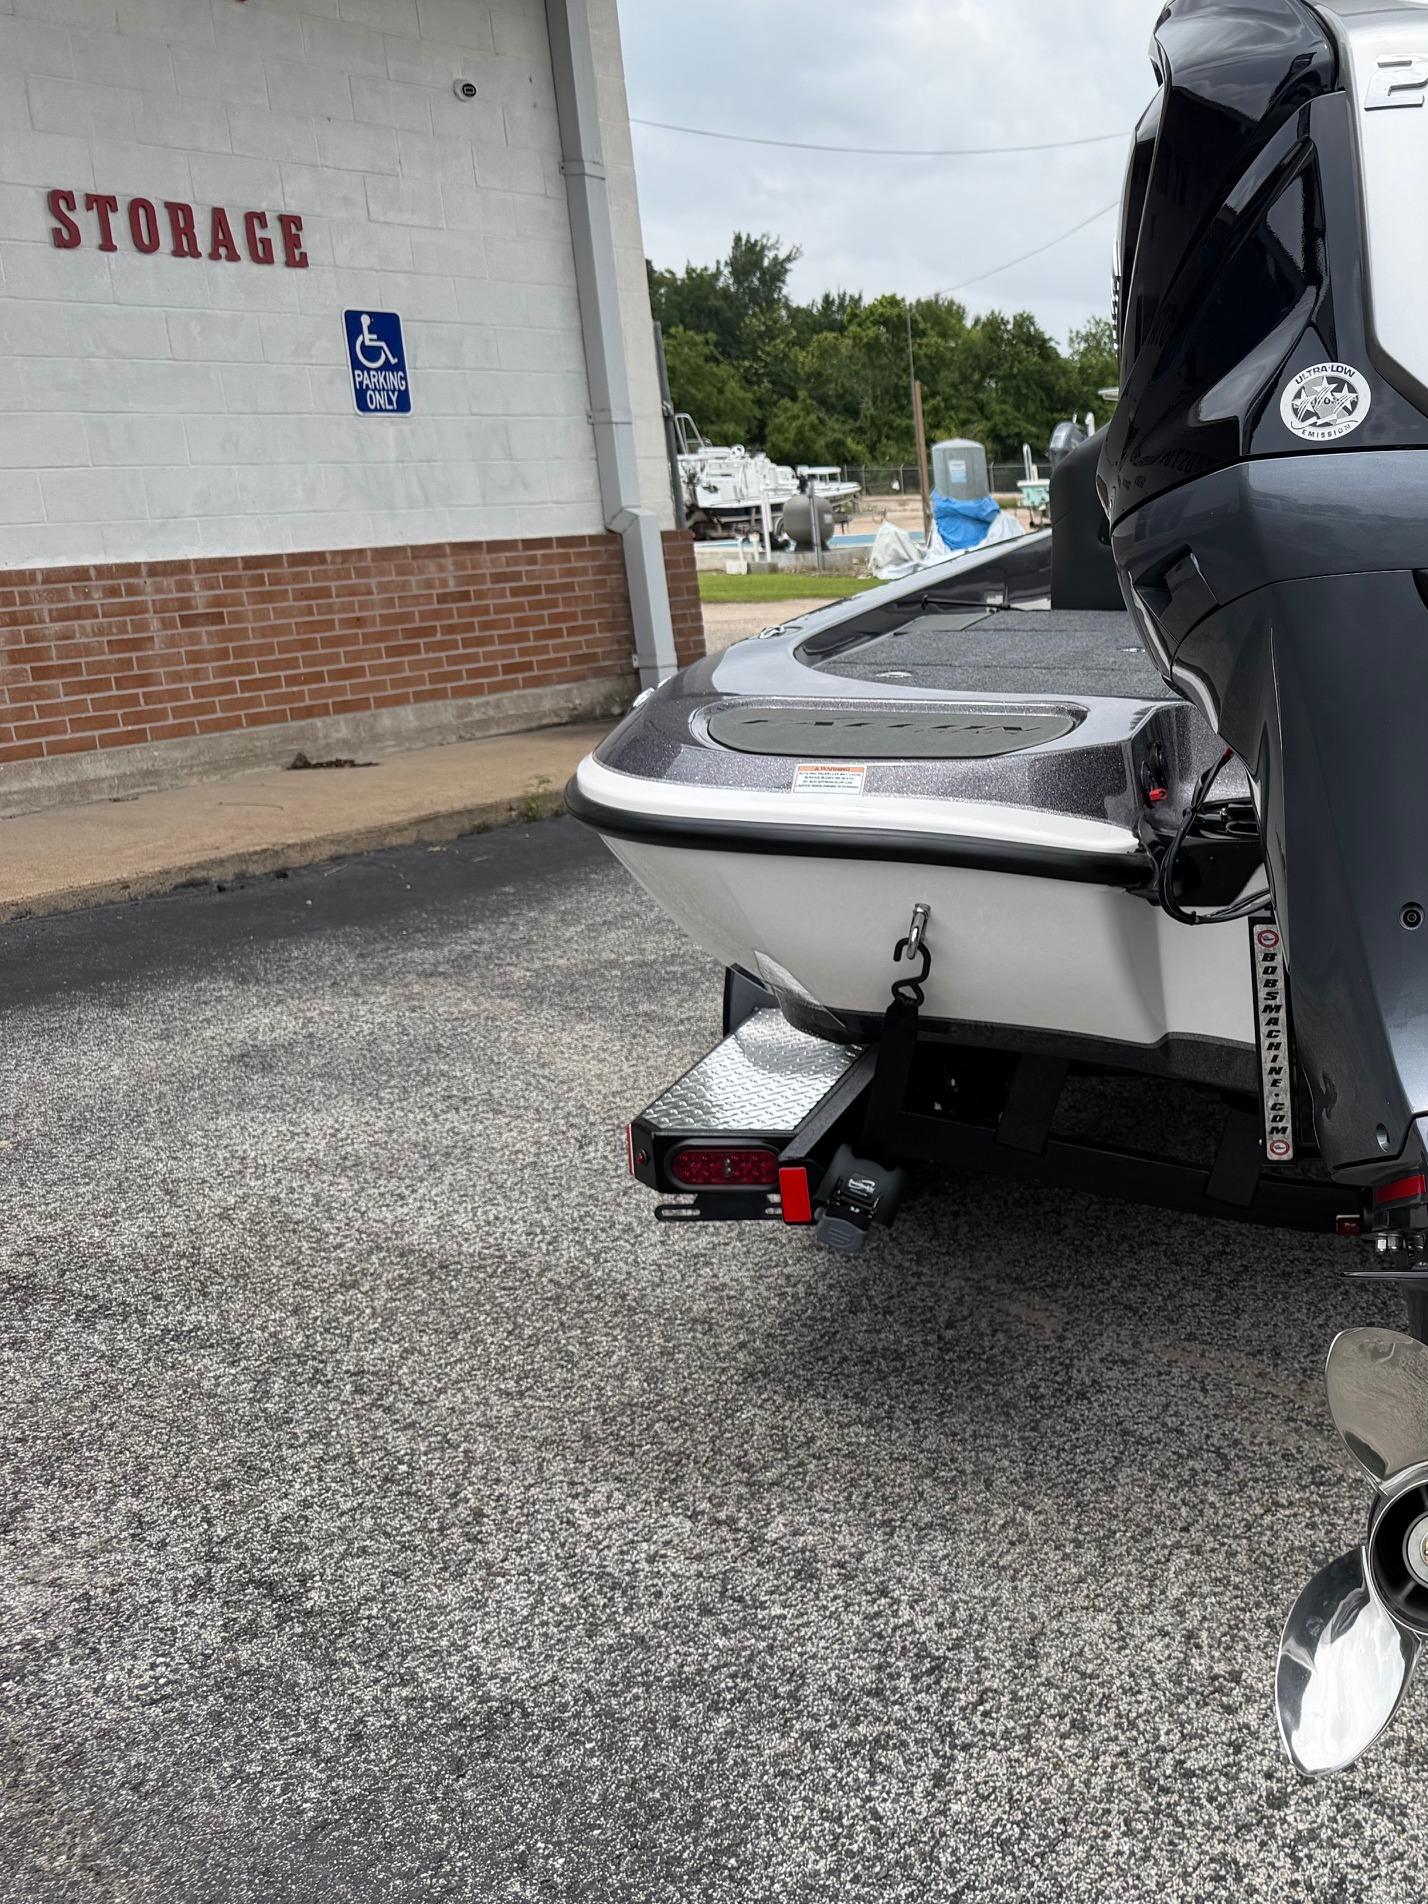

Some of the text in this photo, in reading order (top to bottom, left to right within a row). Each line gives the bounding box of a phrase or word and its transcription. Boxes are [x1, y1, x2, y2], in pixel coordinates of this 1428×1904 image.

[47, 189, 309, 268] STORAGE
[354, 369, 406, 391] PARKING
[366, 390, 398, 410] ONLY
[1301, 423, 1351, 438] EMISSION
[1261, 952, 1289, 1135] BOBSMACHINE.COM
